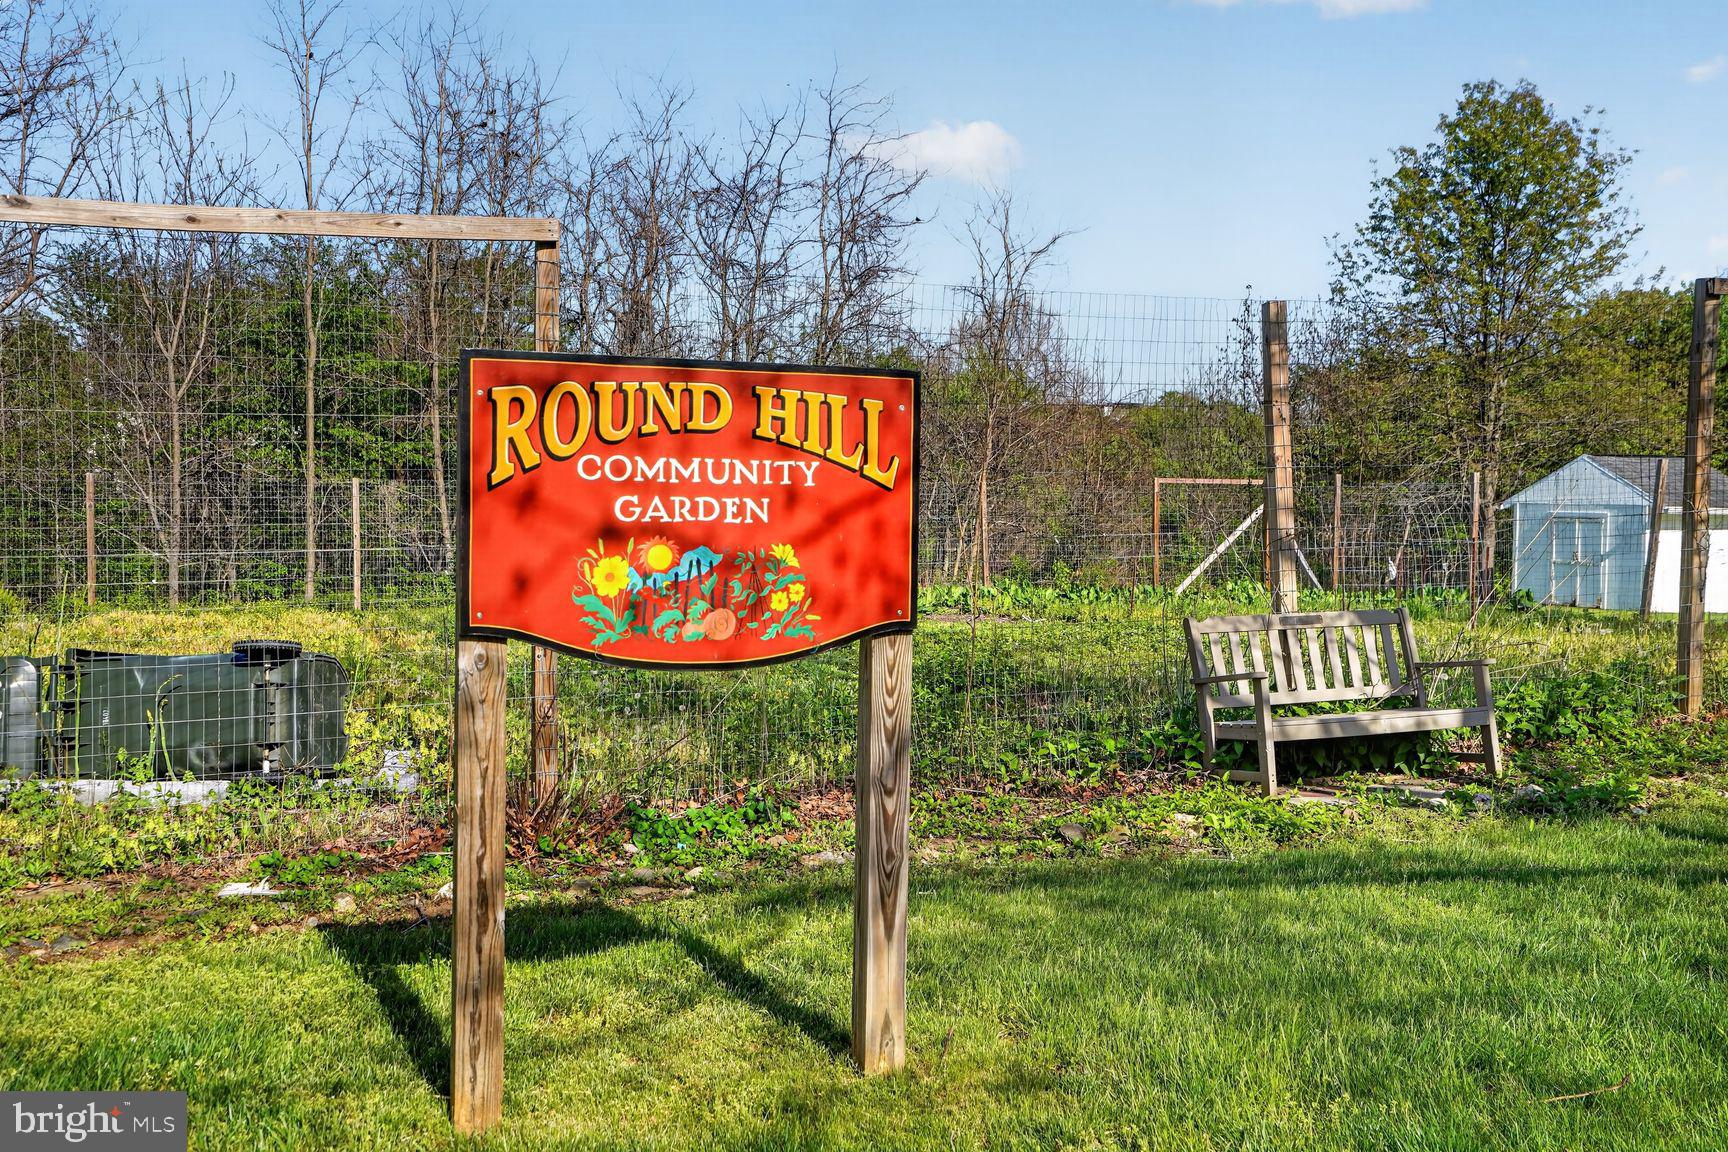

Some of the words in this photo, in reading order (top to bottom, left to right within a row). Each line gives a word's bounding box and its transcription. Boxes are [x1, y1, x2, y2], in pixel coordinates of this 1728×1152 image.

[487, 381, 733, 491] ROUND
[752, 385, 900, 492] HILL
[576, 454, 820, 488] COMMUNITY
[614, 496, 770, 524] GARDEN
